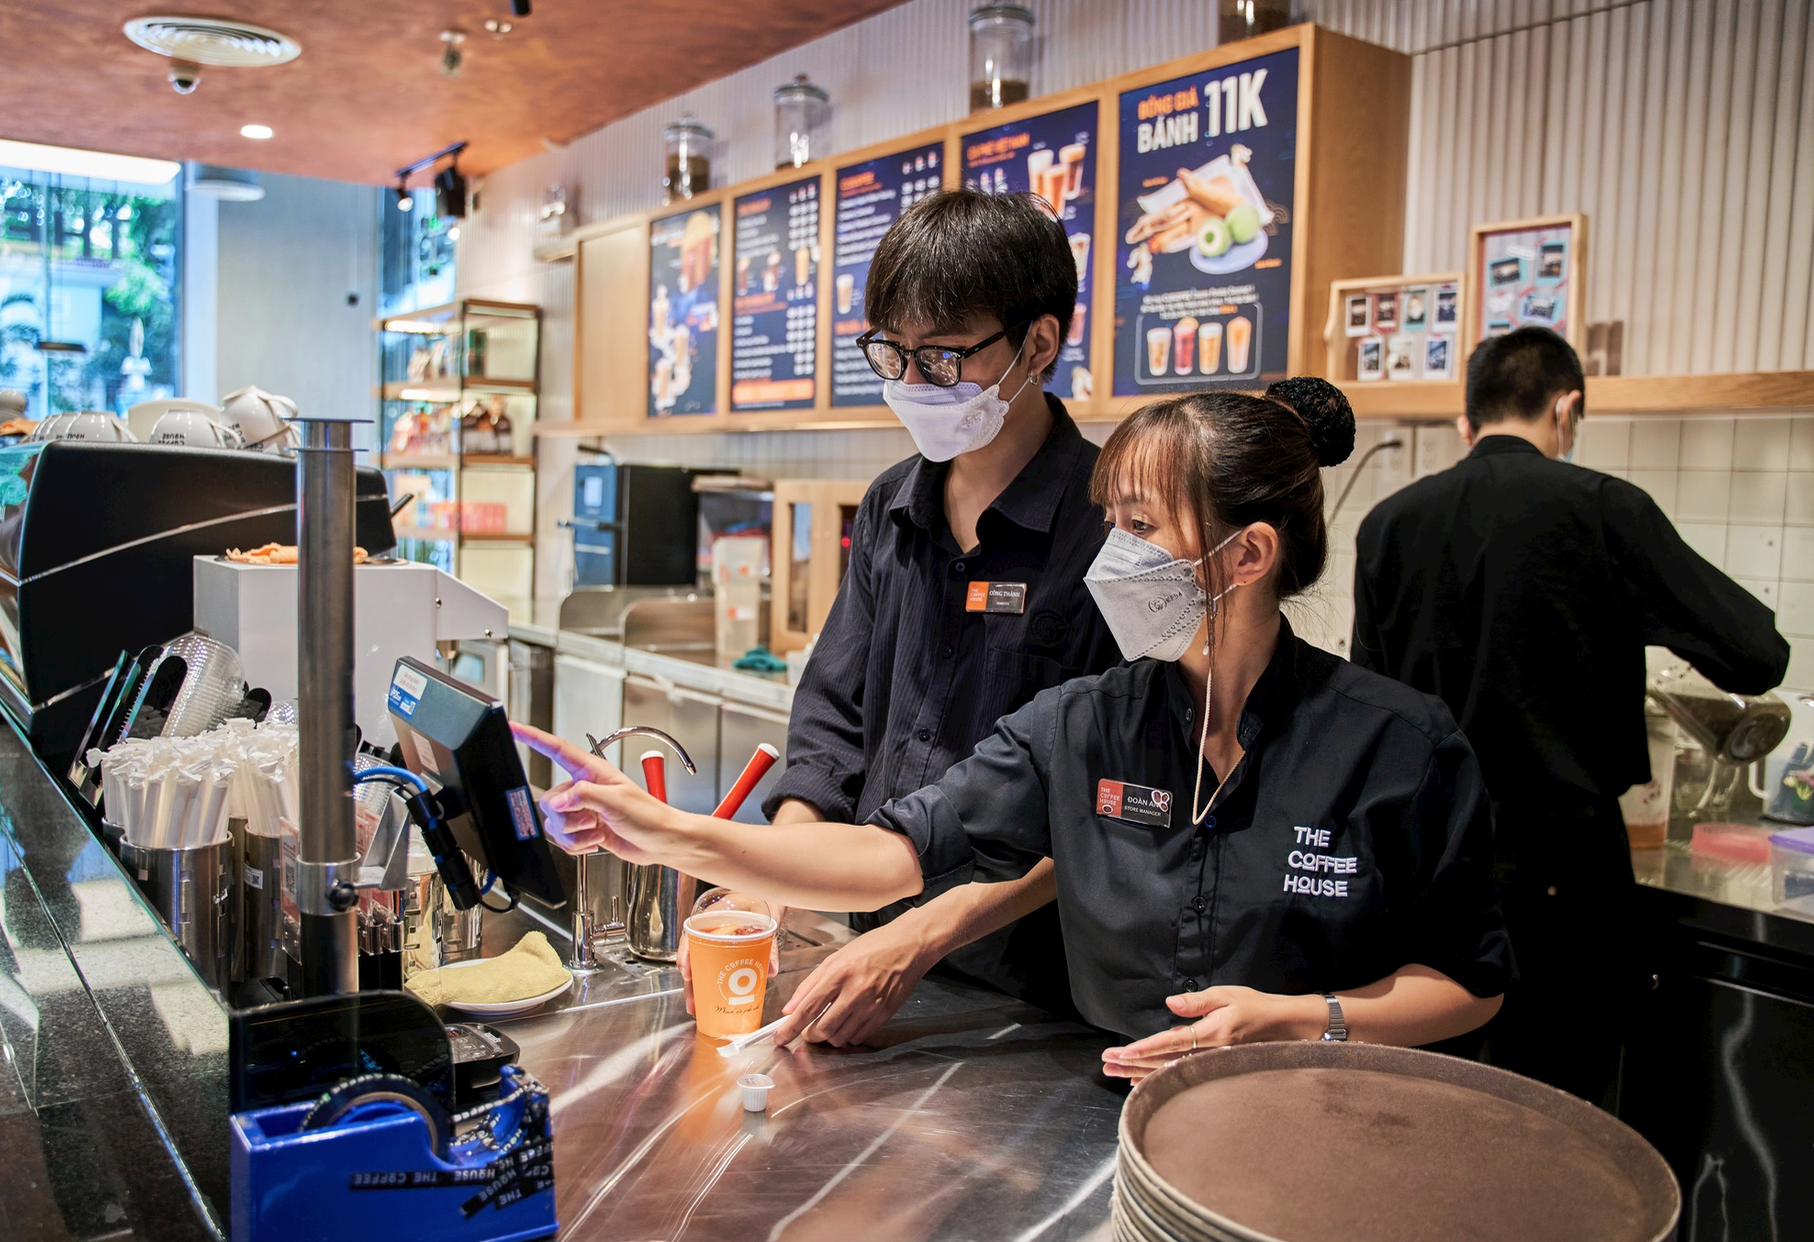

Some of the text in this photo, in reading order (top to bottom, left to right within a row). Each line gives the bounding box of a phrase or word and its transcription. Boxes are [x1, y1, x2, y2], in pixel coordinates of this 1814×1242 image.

[1204, 68, 1268, 138] 11K
[1137, 112, 1199, 154] BÁNH
[1100, 793, 1120, 801] COFFEE
[1100, 798, 1117, 806] HOUSE
[1124, 805, 1162, 817] STORE MANAGER
[1294, 826, 1331, 848] THE
[1287, 850, 1357, 874] COFFEE
[1283, 874, 1348, 898] HOUSE
[717, 970, 727, 985] THE
[725, 958, 754, 972] COFFEE
[354, 1168, 496, 1185] HOUSE THE COFFEE
[479, 1168, 517, 1202] HOUSE
[498, 1188, 523, 1206] THE
